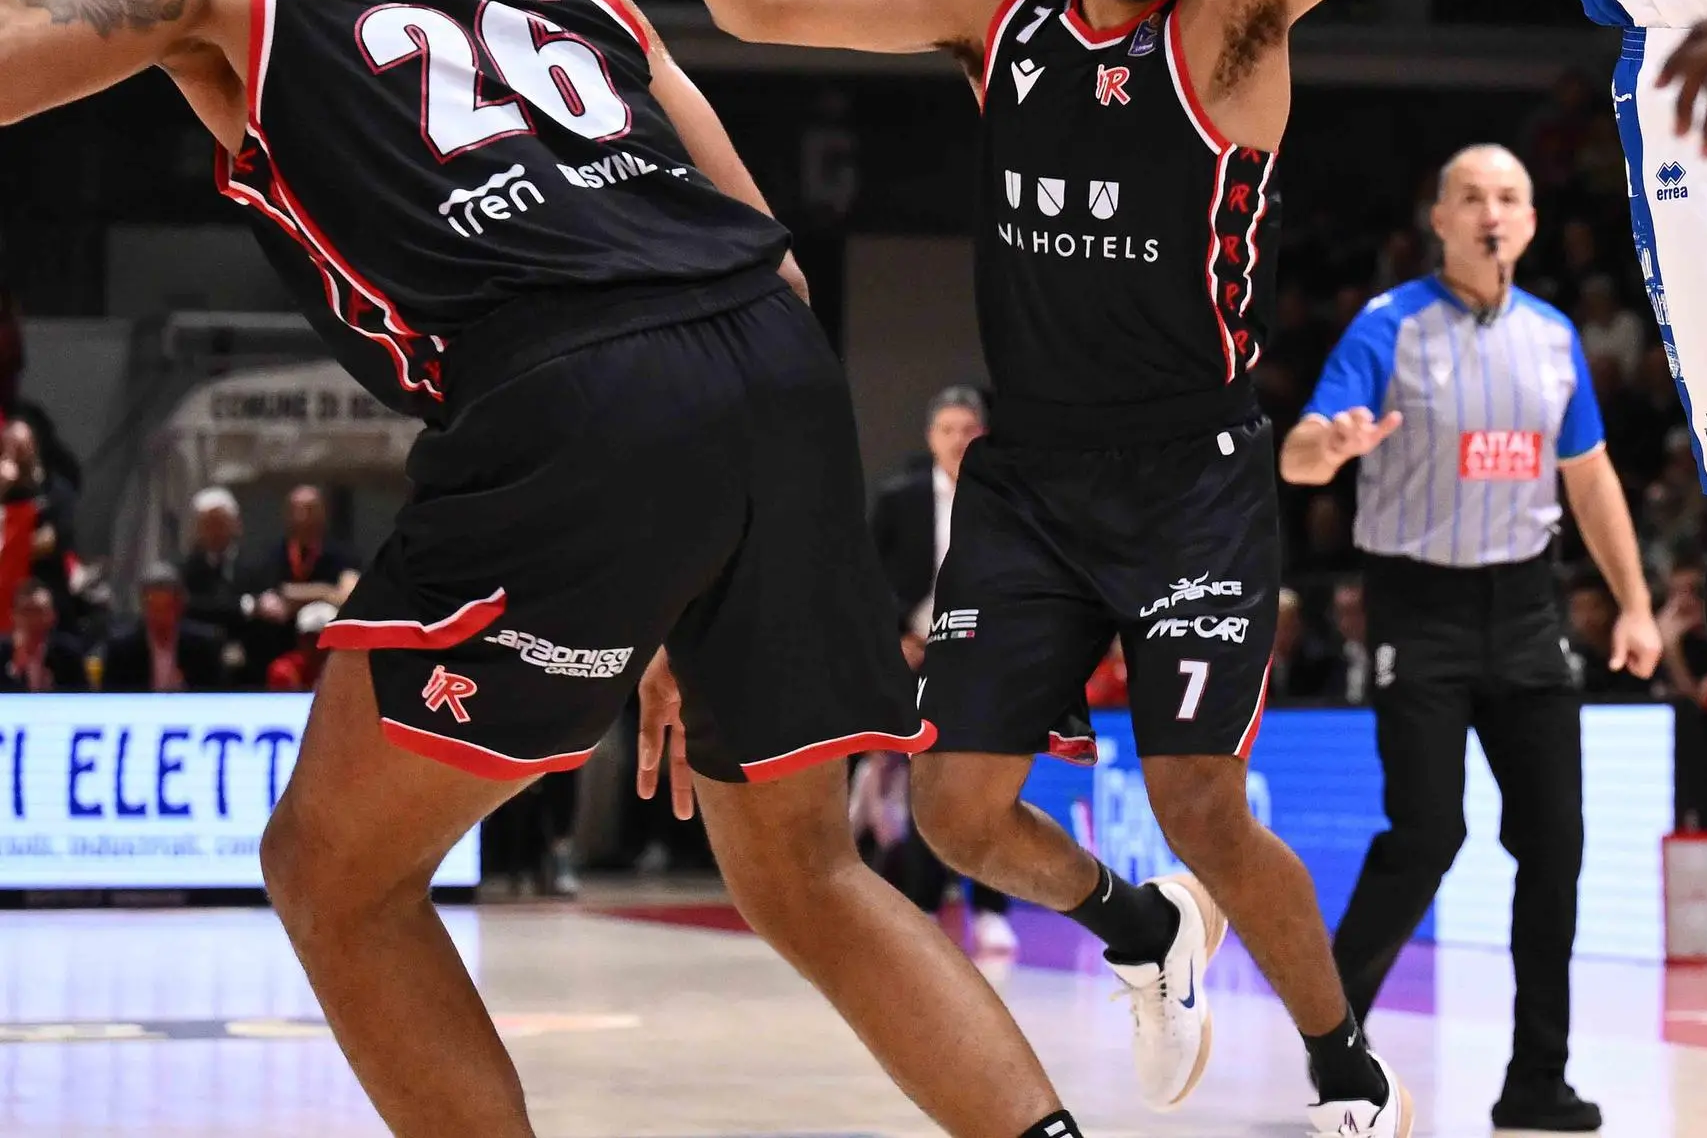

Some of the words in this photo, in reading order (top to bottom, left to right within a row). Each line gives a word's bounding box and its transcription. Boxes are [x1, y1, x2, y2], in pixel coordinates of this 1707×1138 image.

[442, 176, 545, 238] iren
[1656, 185, 1689, 201] errea
[1032, 230, 1159, 263] HOTELS
[1176, 658, 1211, 722] 7
